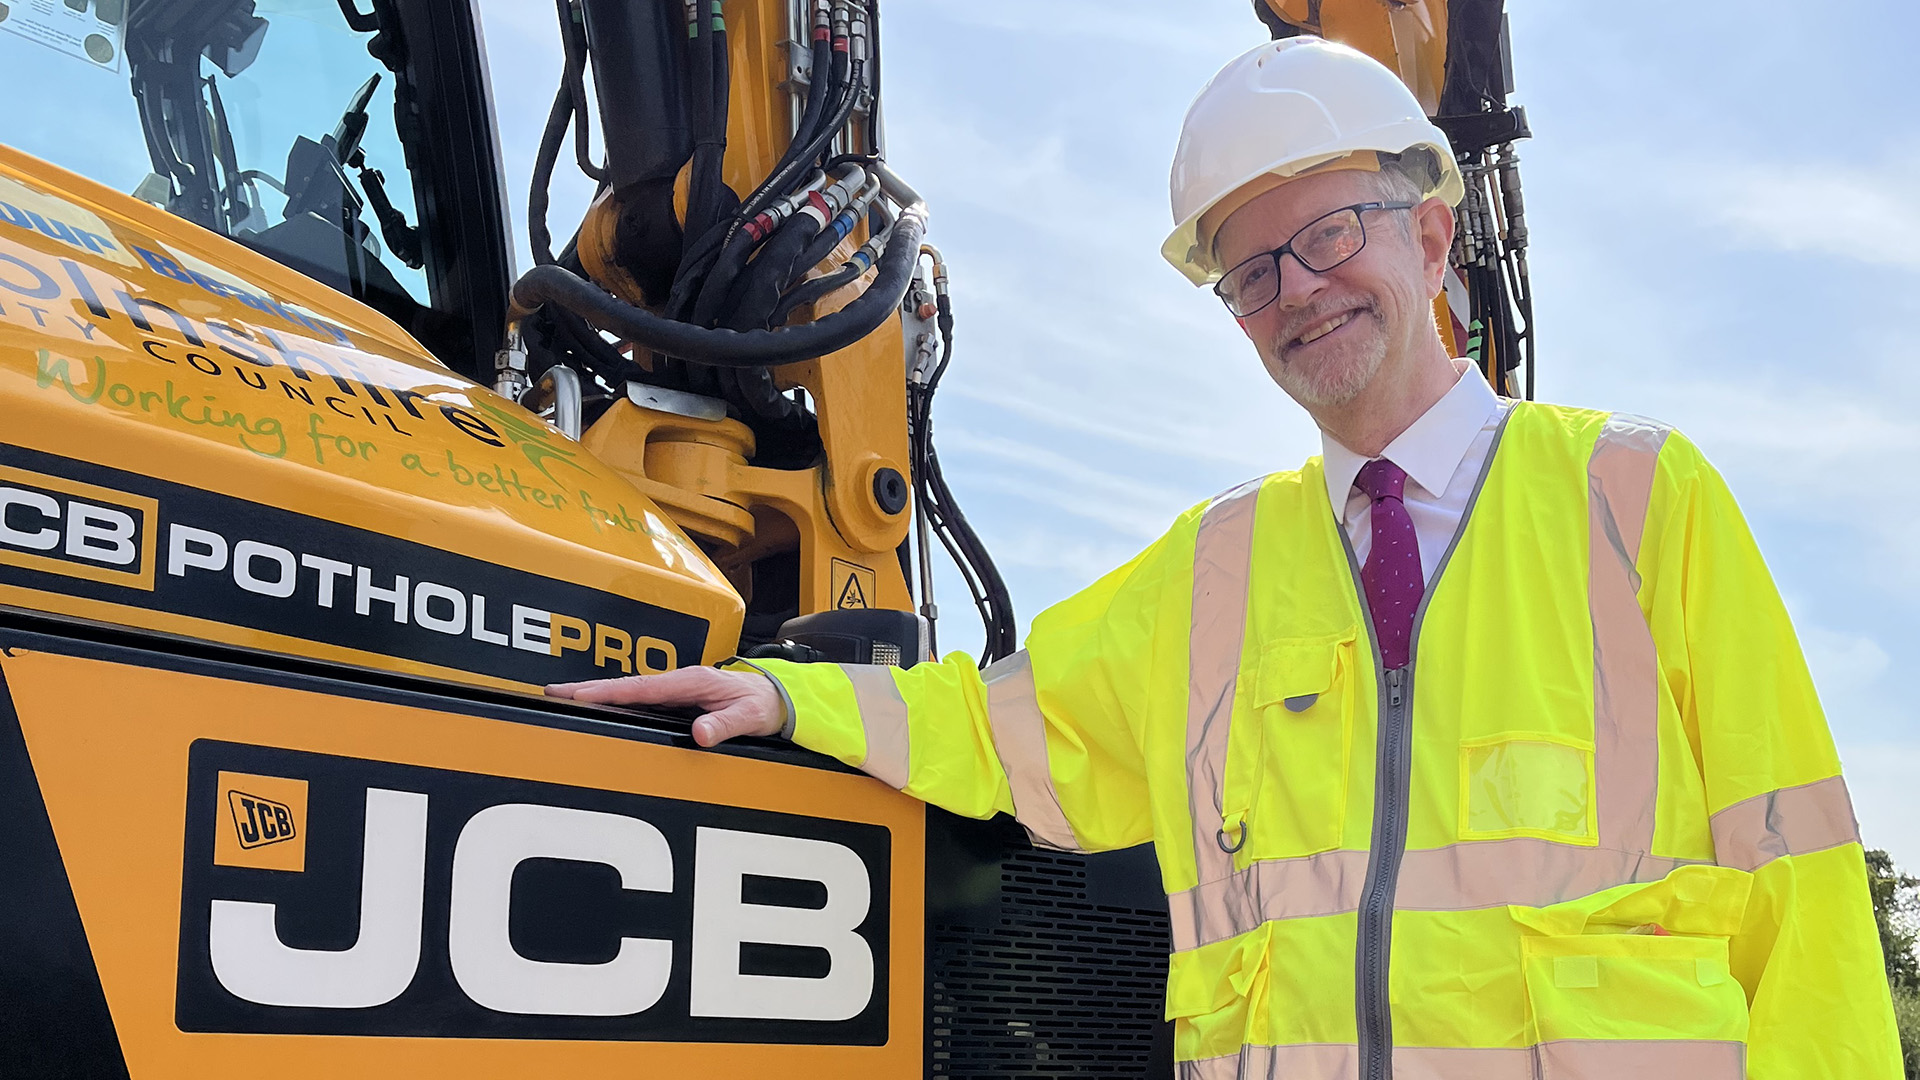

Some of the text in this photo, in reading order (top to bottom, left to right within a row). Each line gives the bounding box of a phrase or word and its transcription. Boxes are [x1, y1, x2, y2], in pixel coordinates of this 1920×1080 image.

[36, 348, 287, 459] Working
[307, 413, 378, 464] for
[401, 453, 439, 477] a
[446, 449, 567, 511] better
[142, 340, 412, 437] COUNCIL
[0, 487, 136, 565] CB
[241, 797, 291, 843] JCB
[210, 786, 875, 1021] JCB
